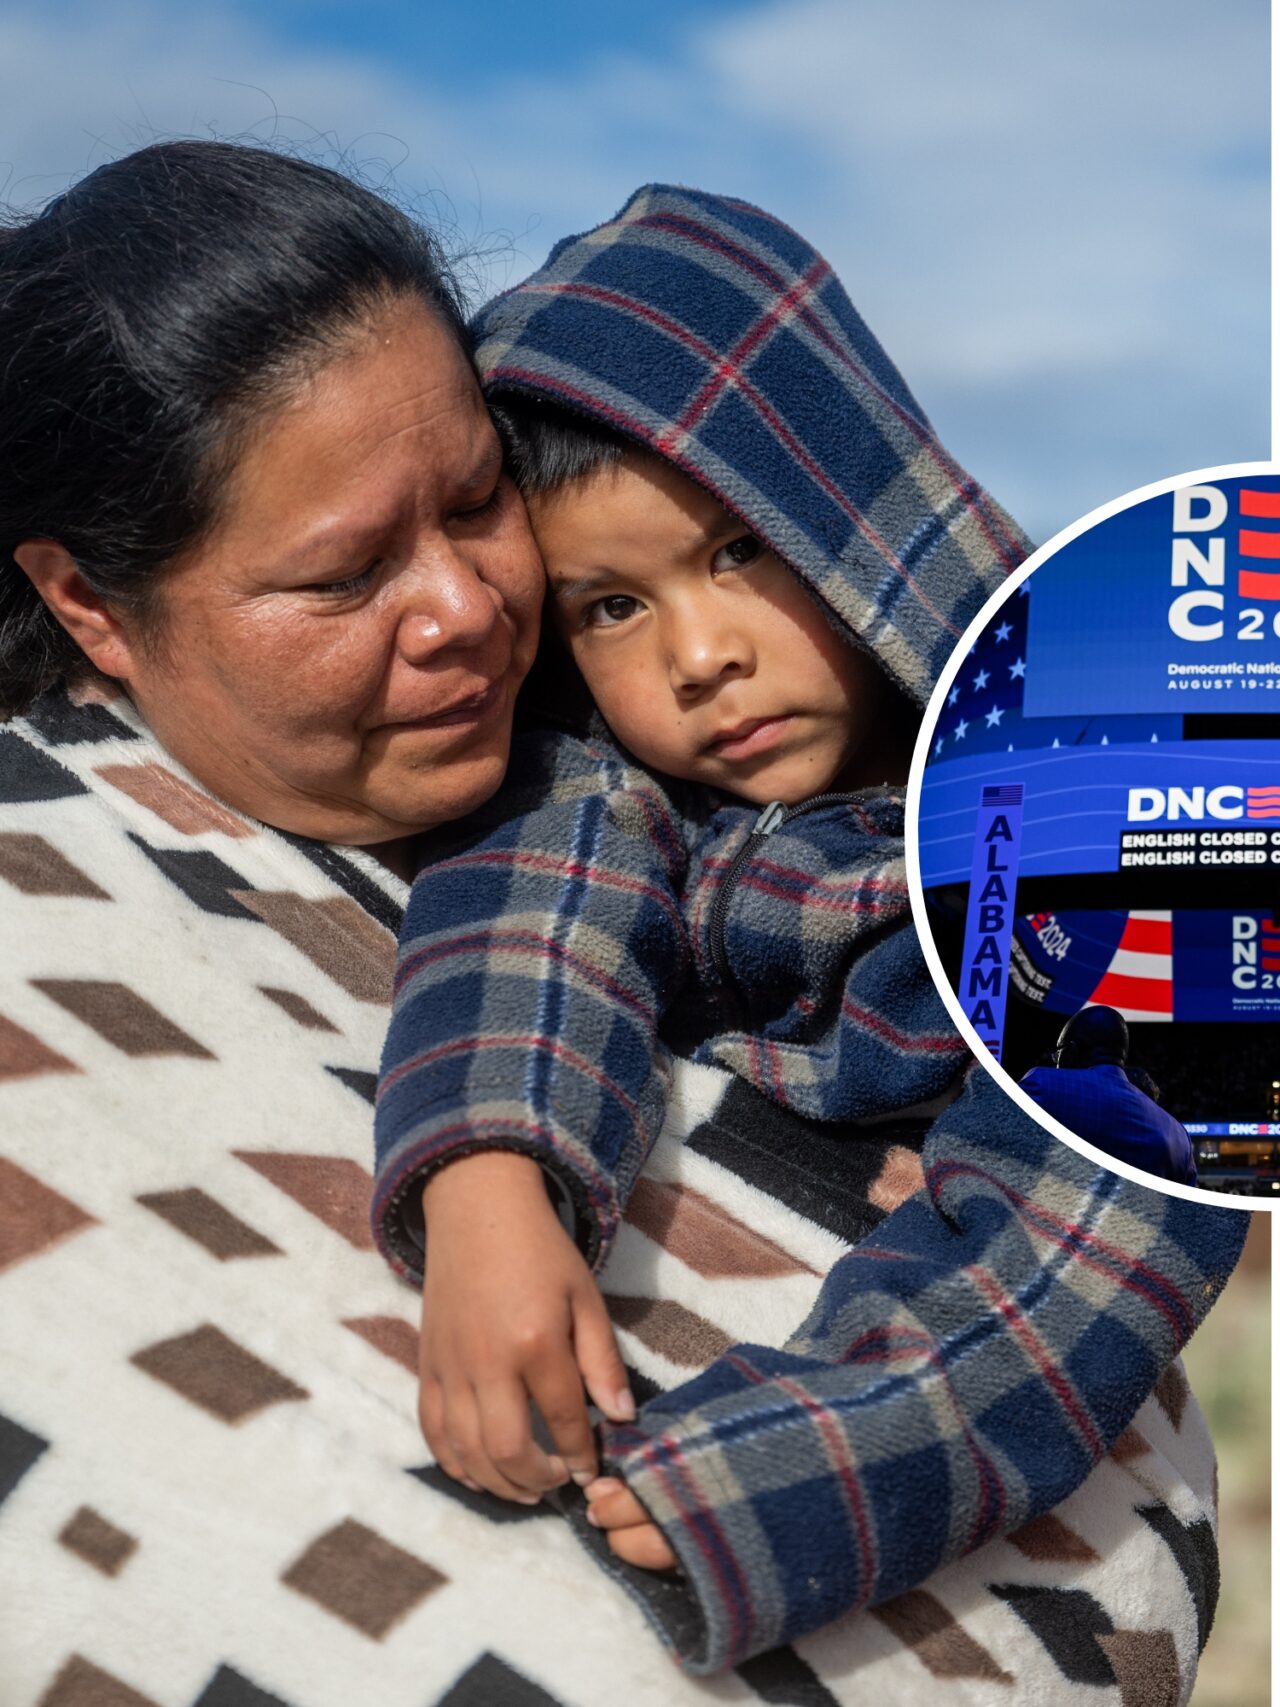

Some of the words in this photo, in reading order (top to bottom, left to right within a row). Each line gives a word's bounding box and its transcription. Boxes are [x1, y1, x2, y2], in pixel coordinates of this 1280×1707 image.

[1168, 485, 1228, 642] DNC
[1168, 662, 1244, 675] Democratic
[1168, 679, 1233, 689] AUGUST
[1127, 785, 1244, 821] DNC
[1122, 833, 1195, 848] ENGLISH
[1200, 832, 1267, 847] CLOSED
[1121, 851, 1195, 866] ENGLISH
[1199, 850, 1267, 864] CLOSED
[970, 815, 1013, 1030] ALABAMA
[1037, 915, 1072, 961] 2024
[1232, 916, 1258, 989] DNC
[1229, 1123, 1259, 1135] DNC
